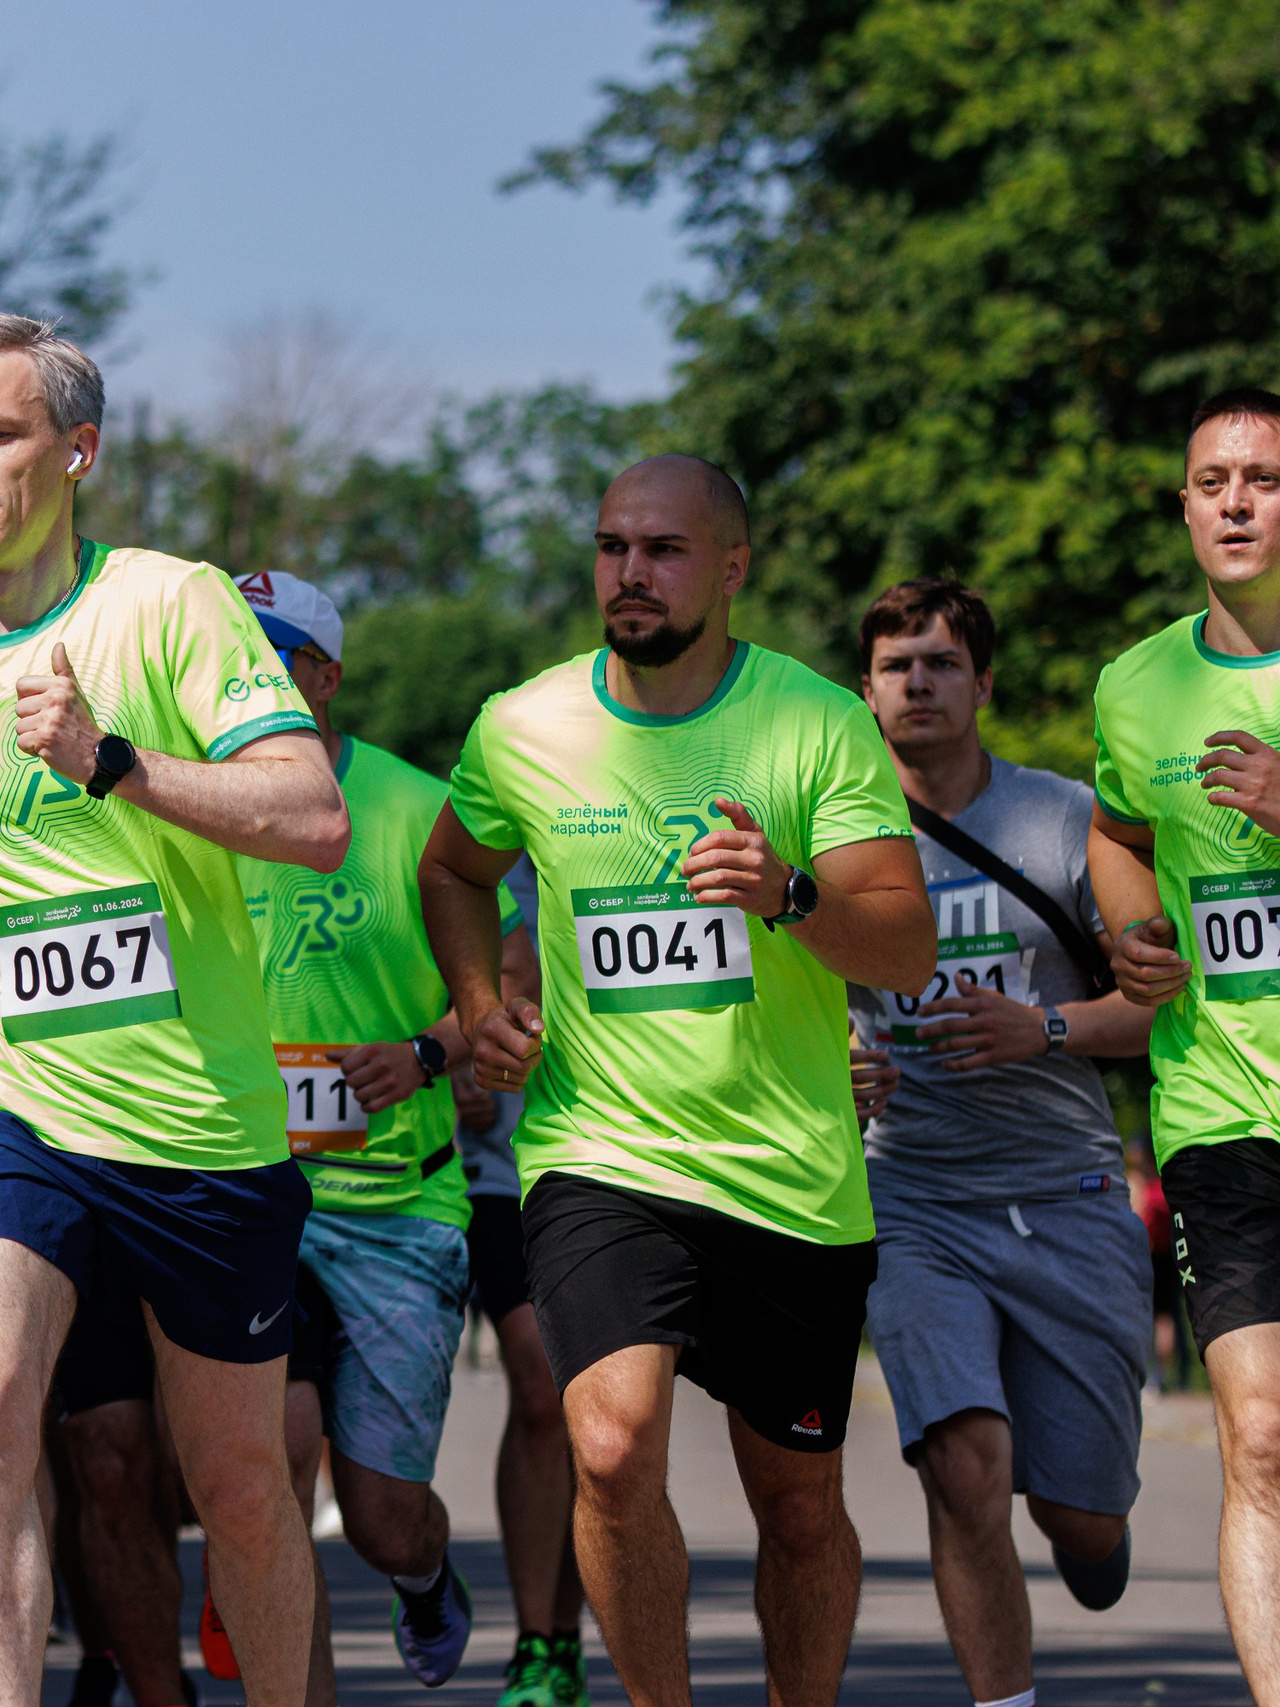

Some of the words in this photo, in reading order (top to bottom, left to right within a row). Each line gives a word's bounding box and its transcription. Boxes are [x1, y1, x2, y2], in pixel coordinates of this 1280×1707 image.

[1155, 750, 1203, 770] зелён
[1150, 767, 1206, 787] марафо
[557, 803, 628, 819] зелёный
[550, 819, 622, 838] марафон
[1210, 884, 1229, 893] СБЕР
[16, 915, 34, 925] СБЕР
[92, 897, 143, 913] 01.06.2024
[600, 898, 623, 907] СБЕР
[591, 918, 728, 977] 0041
[14, 926, 151, 1001] 0067
[282, 1077, 347, 1121] 11
[791, 1423, 823, 1436] Reebok
